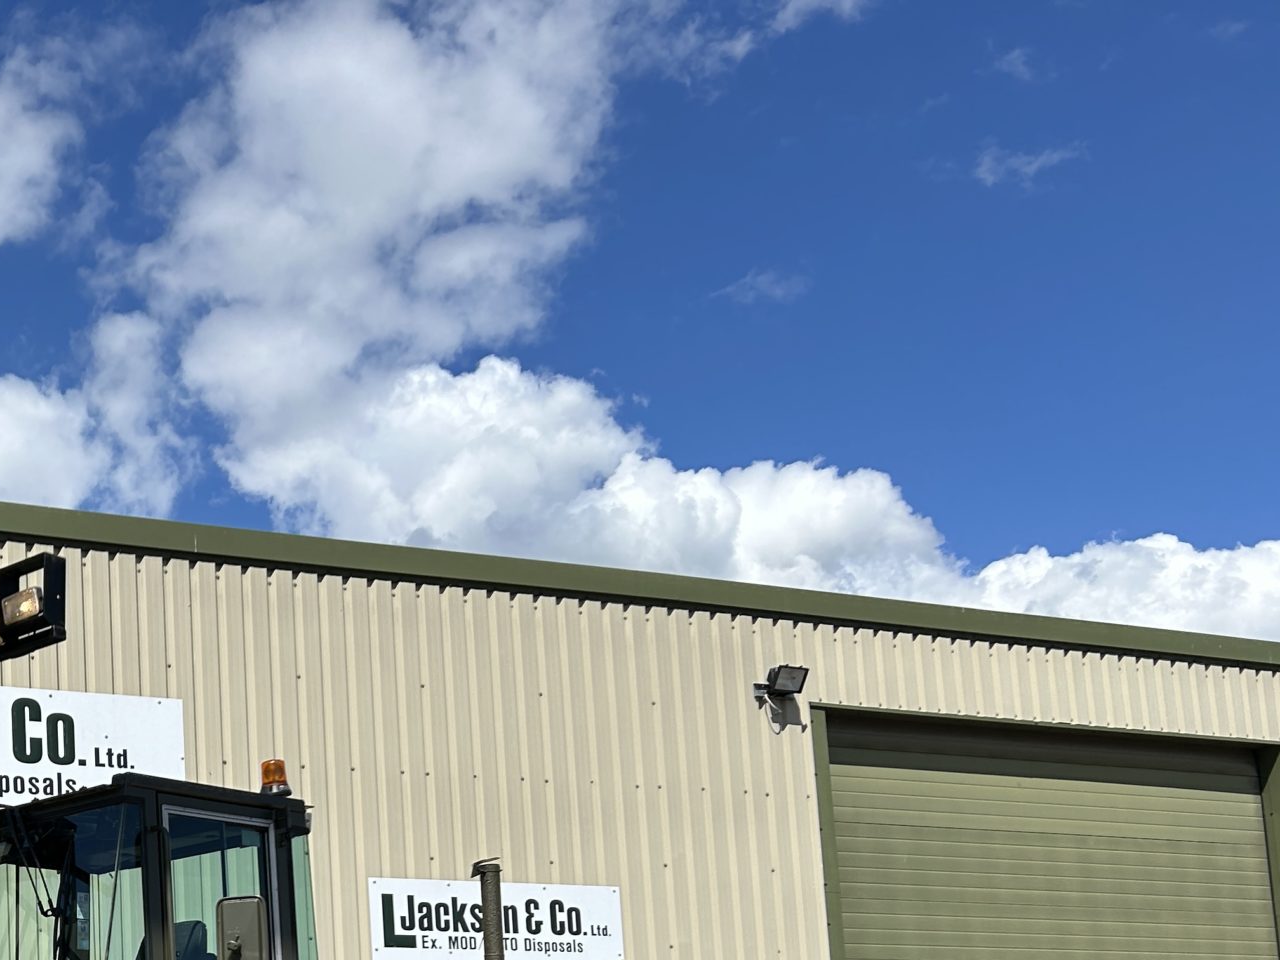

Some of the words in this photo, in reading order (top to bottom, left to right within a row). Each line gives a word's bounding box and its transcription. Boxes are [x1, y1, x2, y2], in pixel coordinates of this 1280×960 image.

[11, 697, 87, 766] Co.
[94, 746, 135, 770] Ltd.
[524, 898, 543, 936] &
[549, 899, 587, 936] Co.
[590, 924, 612, 937] Ltd.
[422, 935, 442, 950] Ex.
[448, 935, 518, 951] MOD/TO
[524, 937, 584, 955] Disposals
